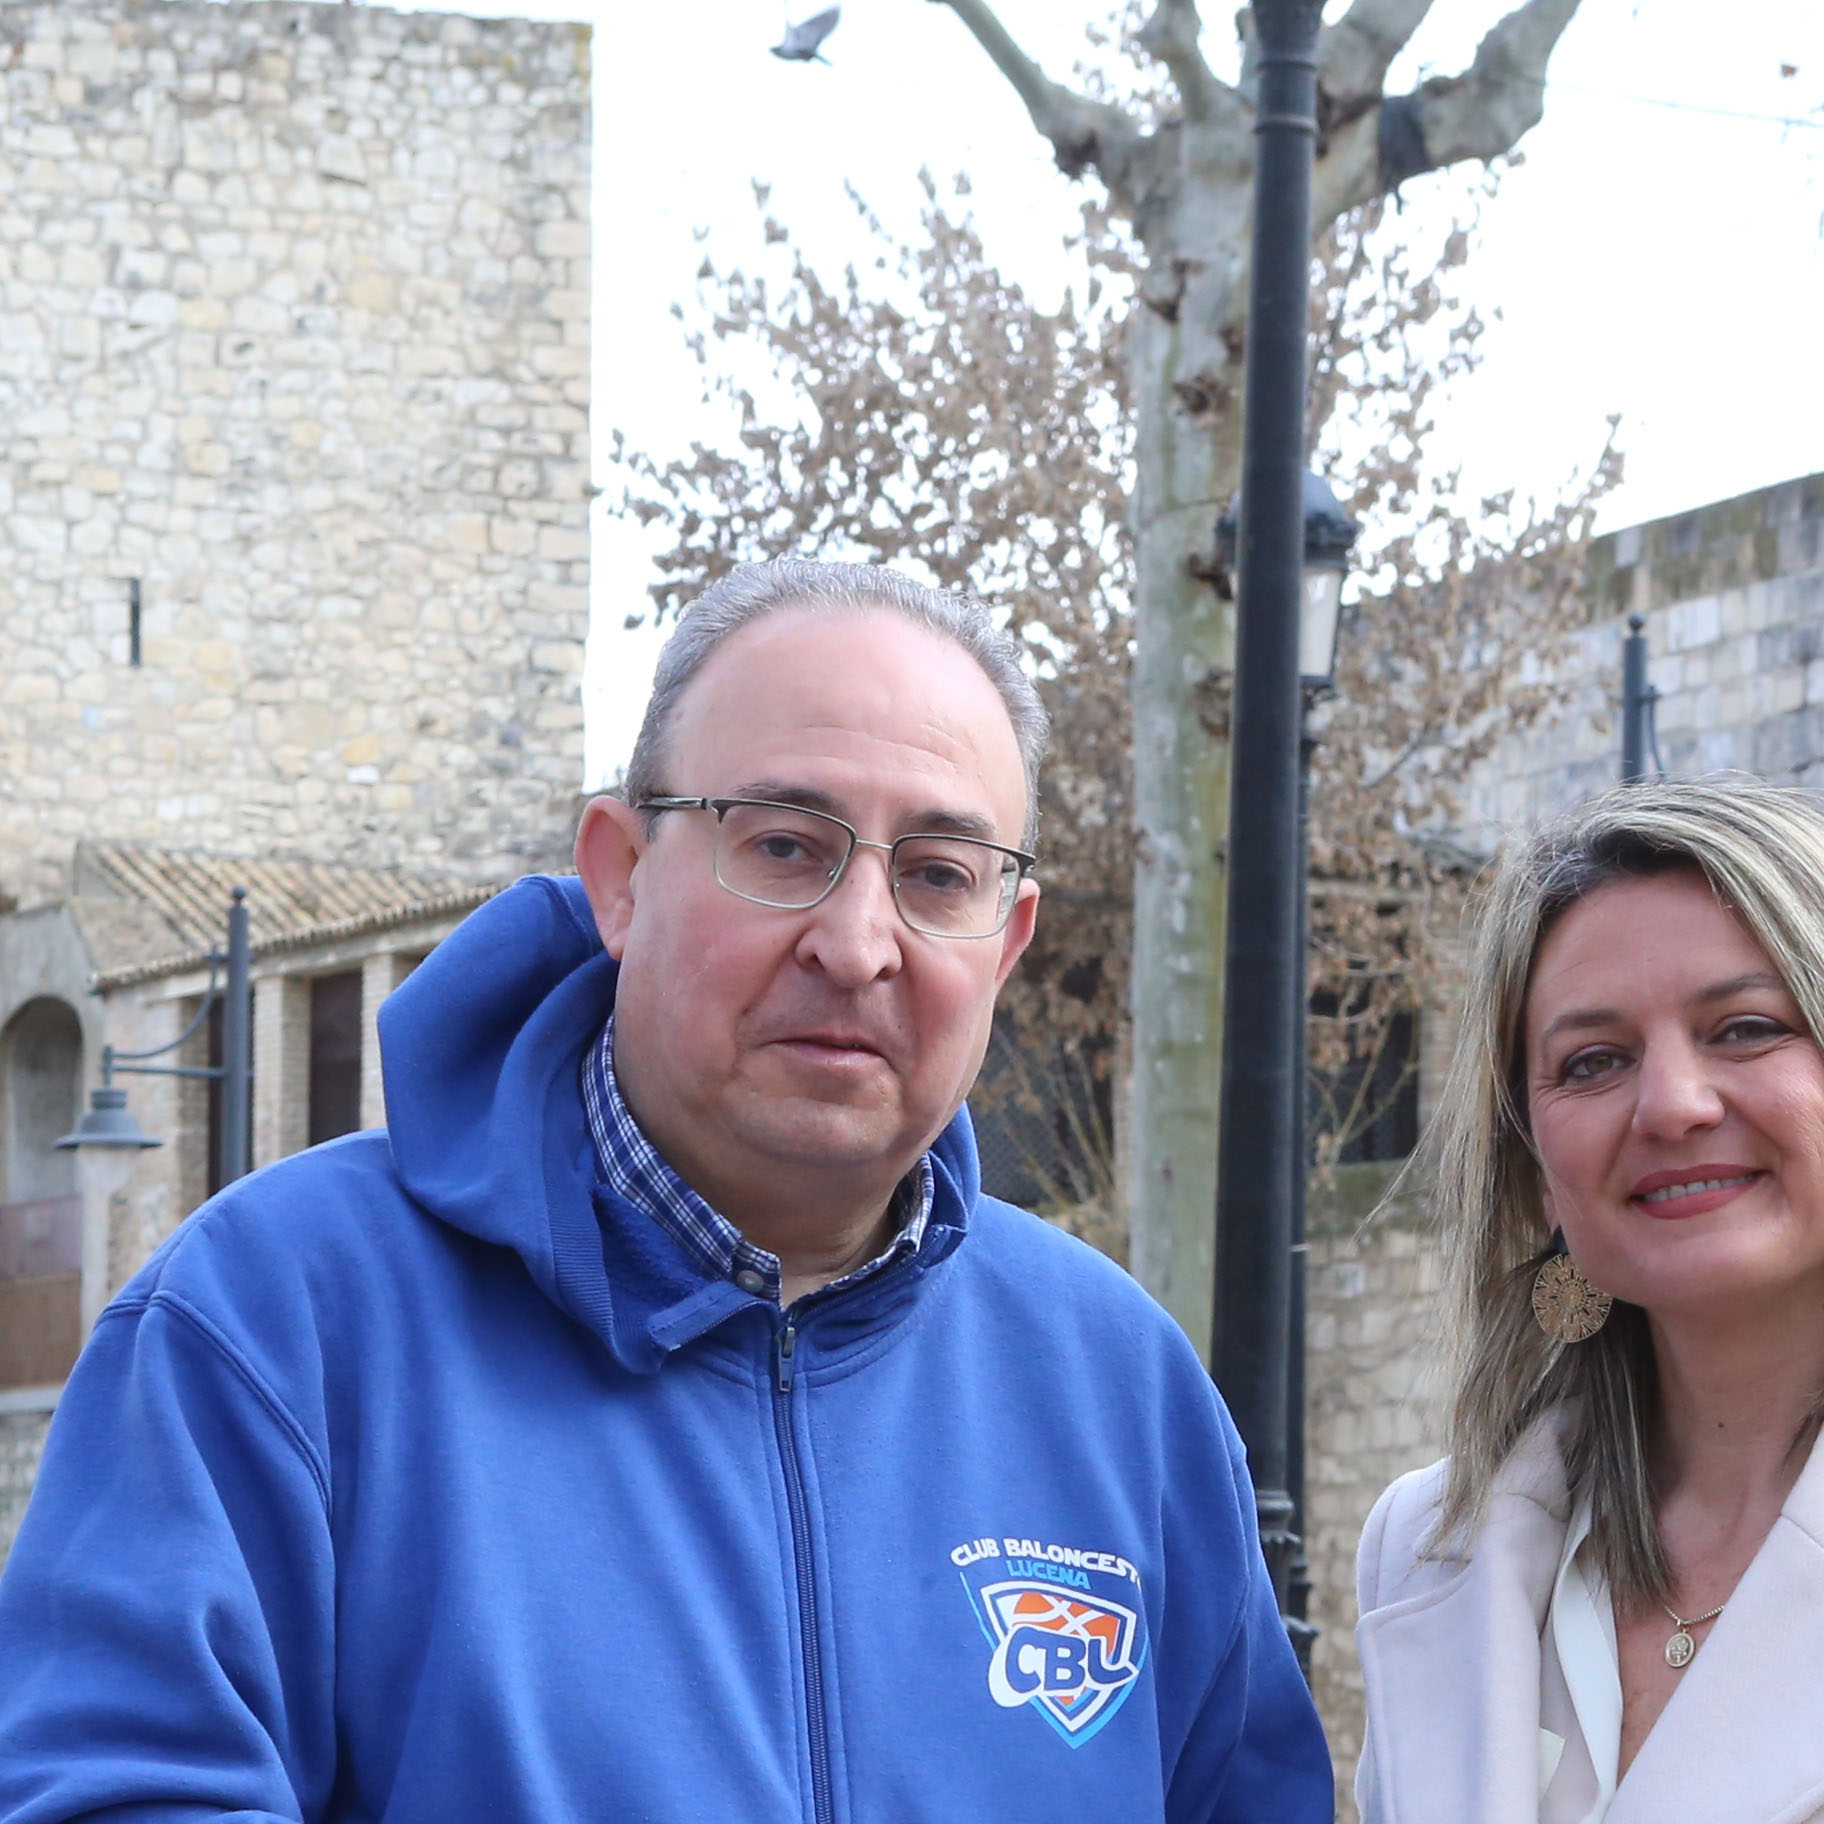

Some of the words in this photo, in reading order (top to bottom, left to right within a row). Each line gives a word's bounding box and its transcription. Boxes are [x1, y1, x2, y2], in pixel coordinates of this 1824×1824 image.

[950, 1537, 1001, 1567] CLUB
[1002, 1538, 1144, 1594] BALONCEST
[1005, 1559, 1091, 1590] LUCENA
